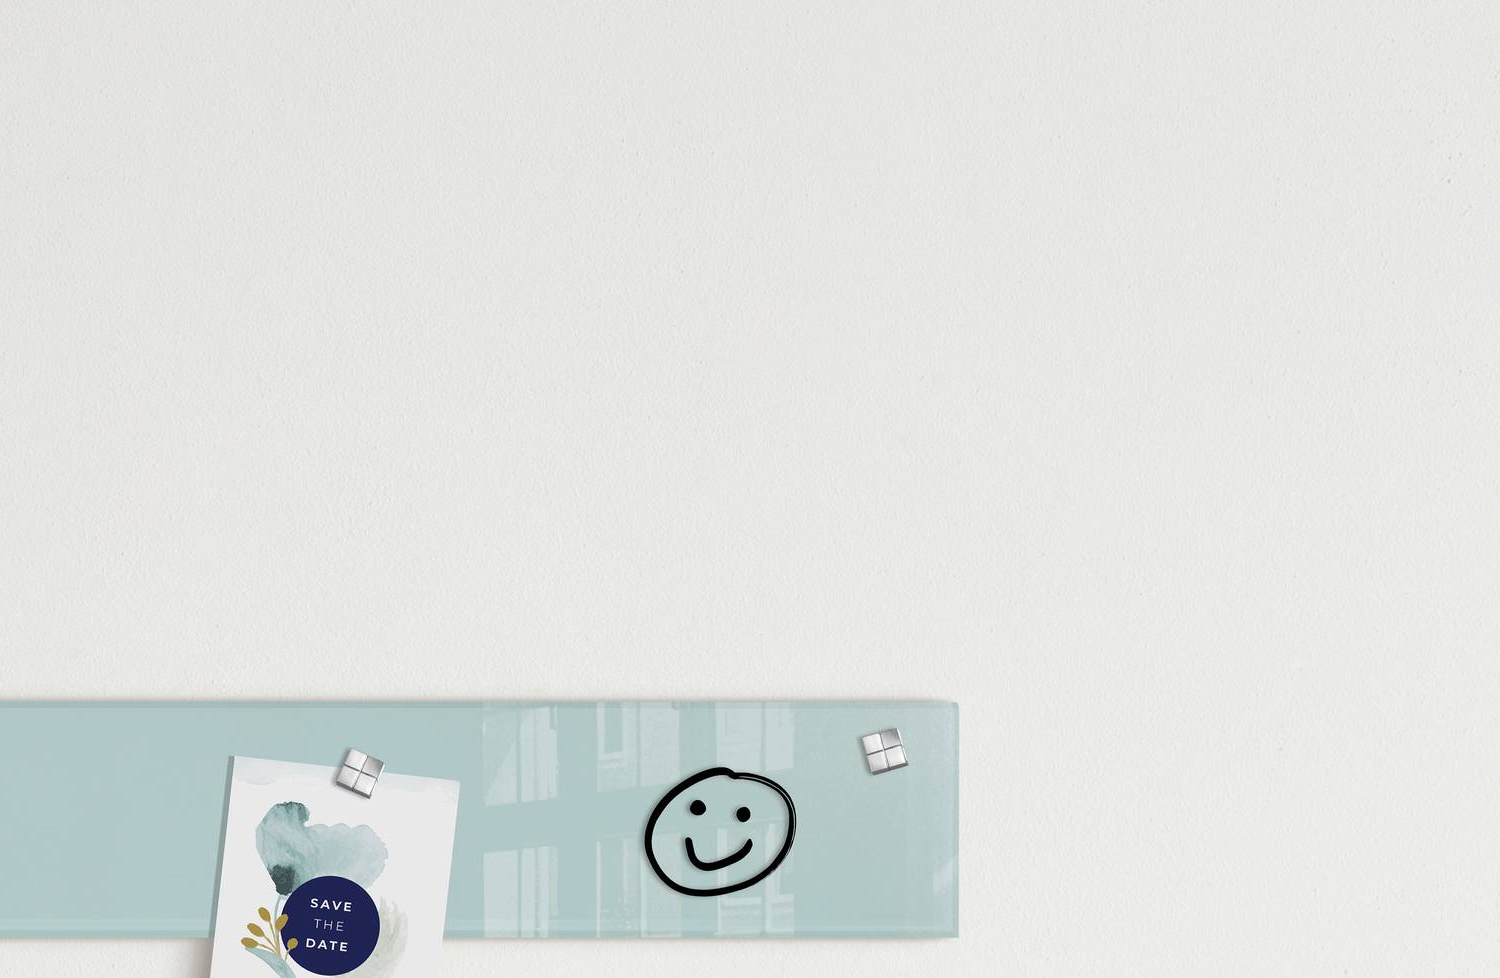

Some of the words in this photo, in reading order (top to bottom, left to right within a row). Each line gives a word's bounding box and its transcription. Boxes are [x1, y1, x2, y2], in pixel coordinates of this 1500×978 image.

[310, 898, 352, 912] SAVE
[314, 918, 344, 931] THE
[306, 938, 348, 952] DATE
